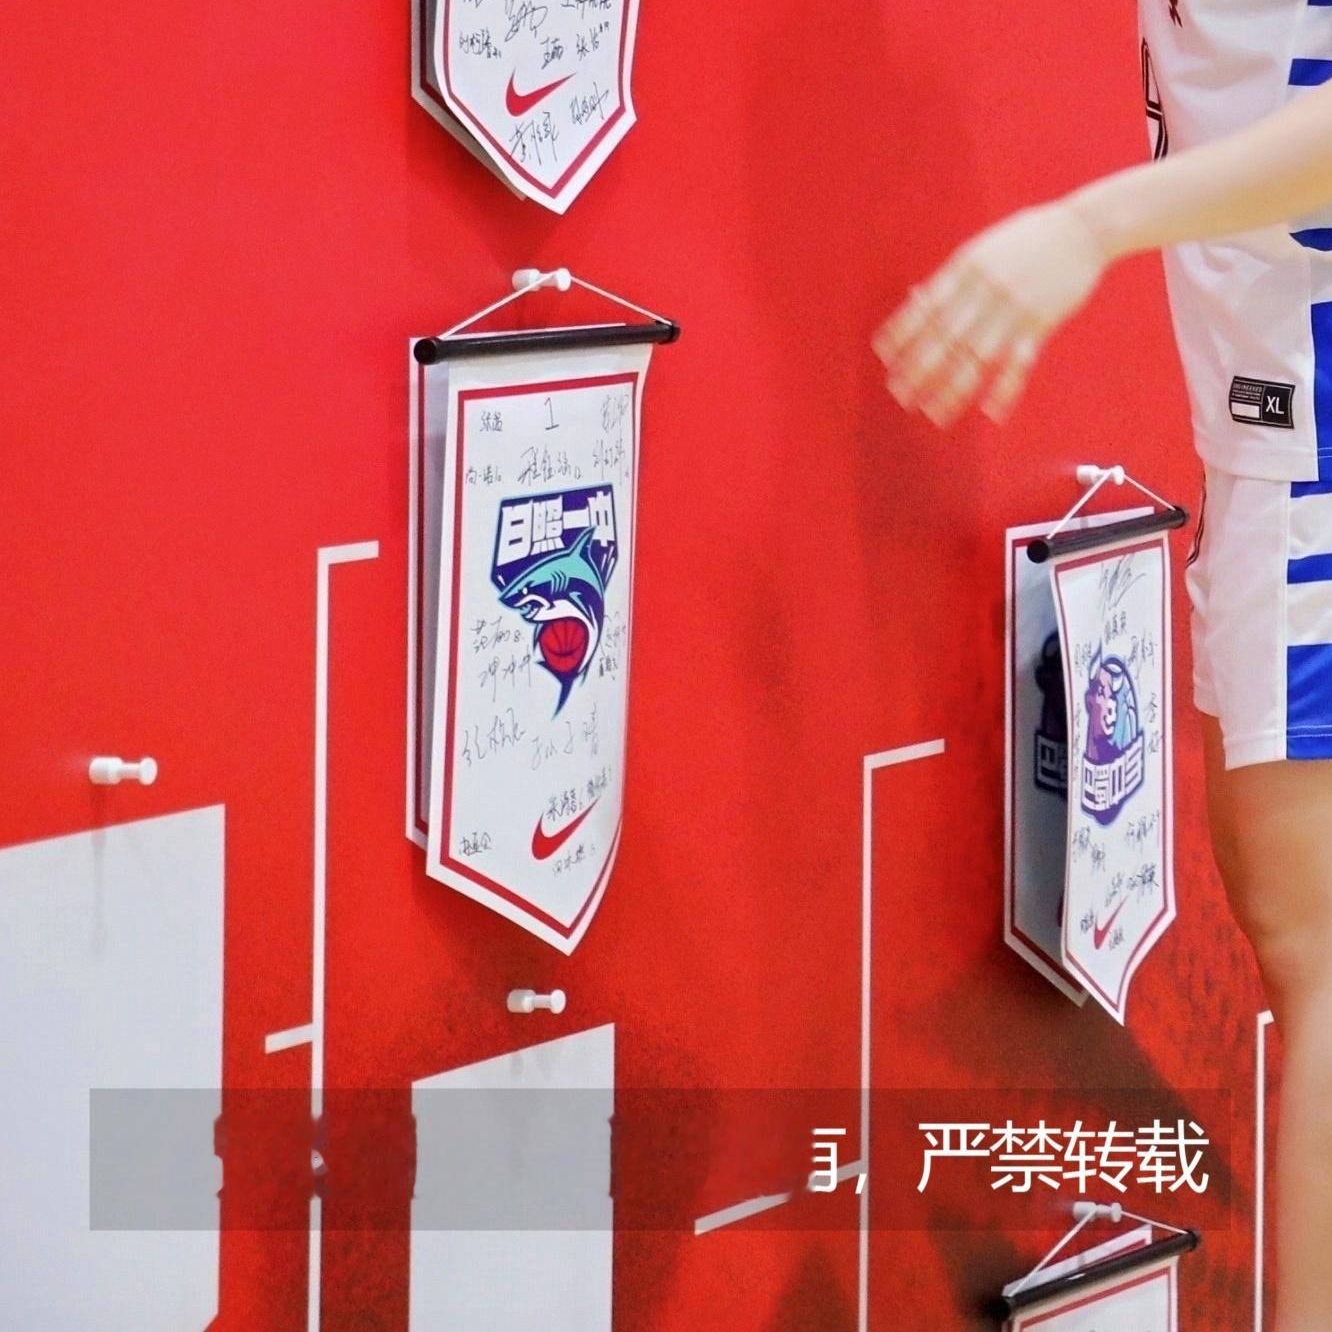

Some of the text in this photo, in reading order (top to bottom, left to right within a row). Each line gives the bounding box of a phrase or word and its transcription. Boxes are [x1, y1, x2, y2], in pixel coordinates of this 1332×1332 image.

[1265, 395, 1285, 415] XL
[496, 490, 616, 567] 日照一中
